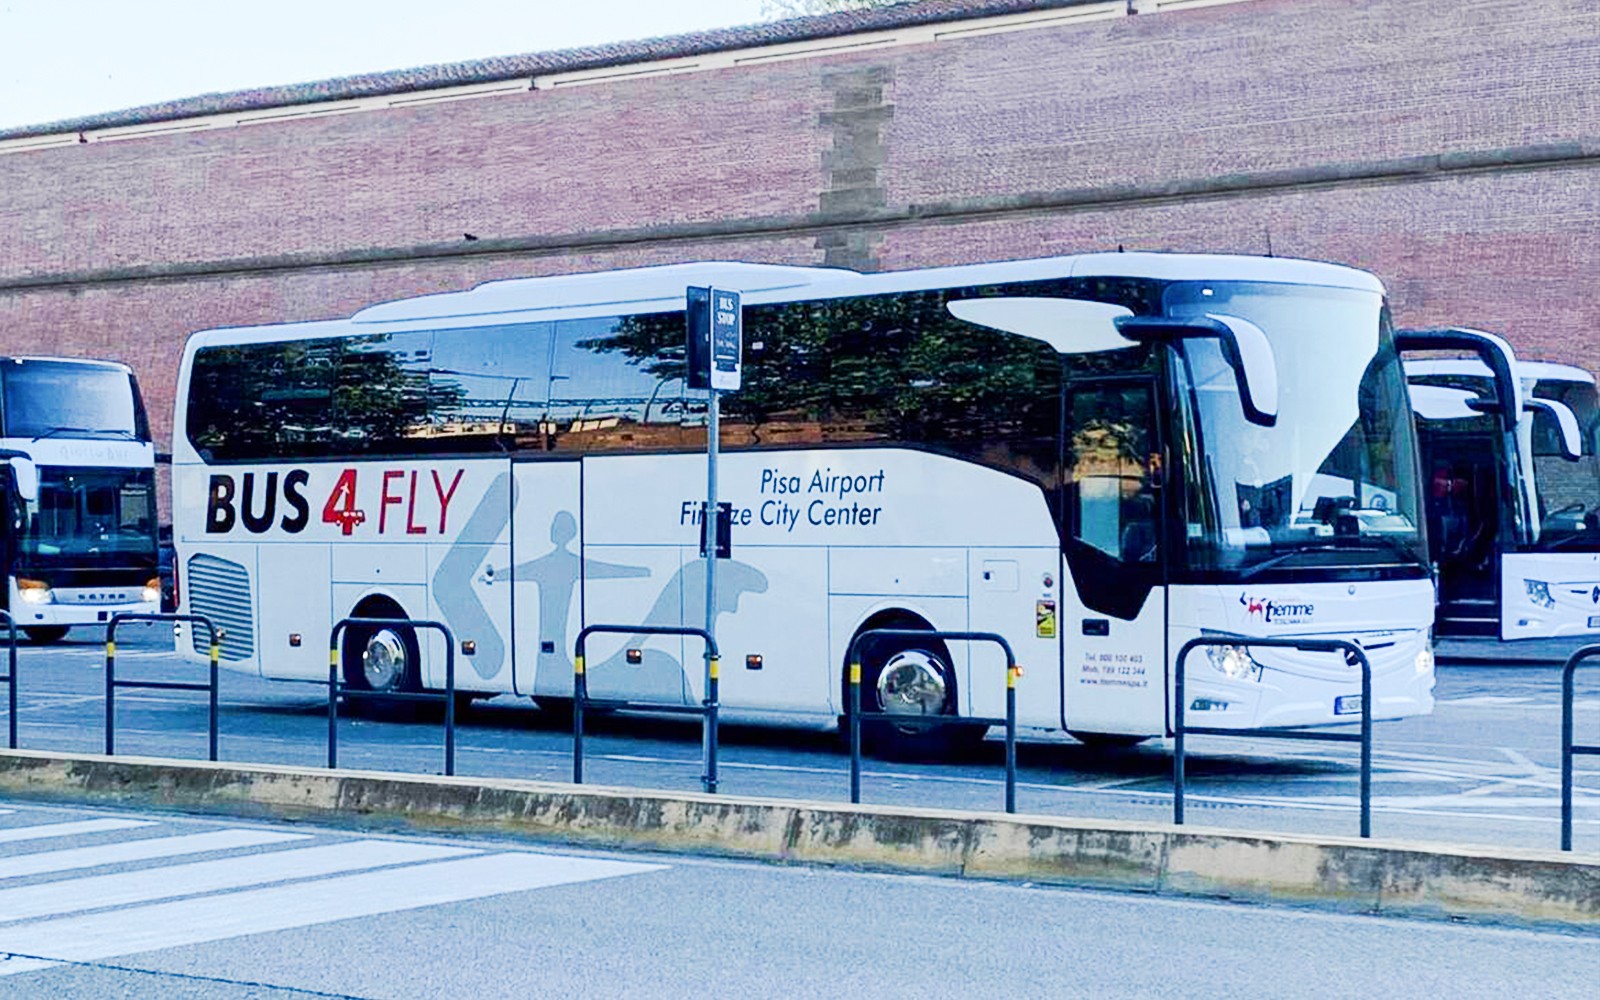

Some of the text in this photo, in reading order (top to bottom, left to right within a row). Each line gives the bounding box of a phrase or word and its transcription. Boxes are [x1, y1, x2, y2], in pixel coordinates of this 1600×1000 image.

[761, 468, 885, 500] Pisa Airport
[206, 469, 465, 536] BUS 4 FLY
[680, 500, 882, 532] Firze City Center
